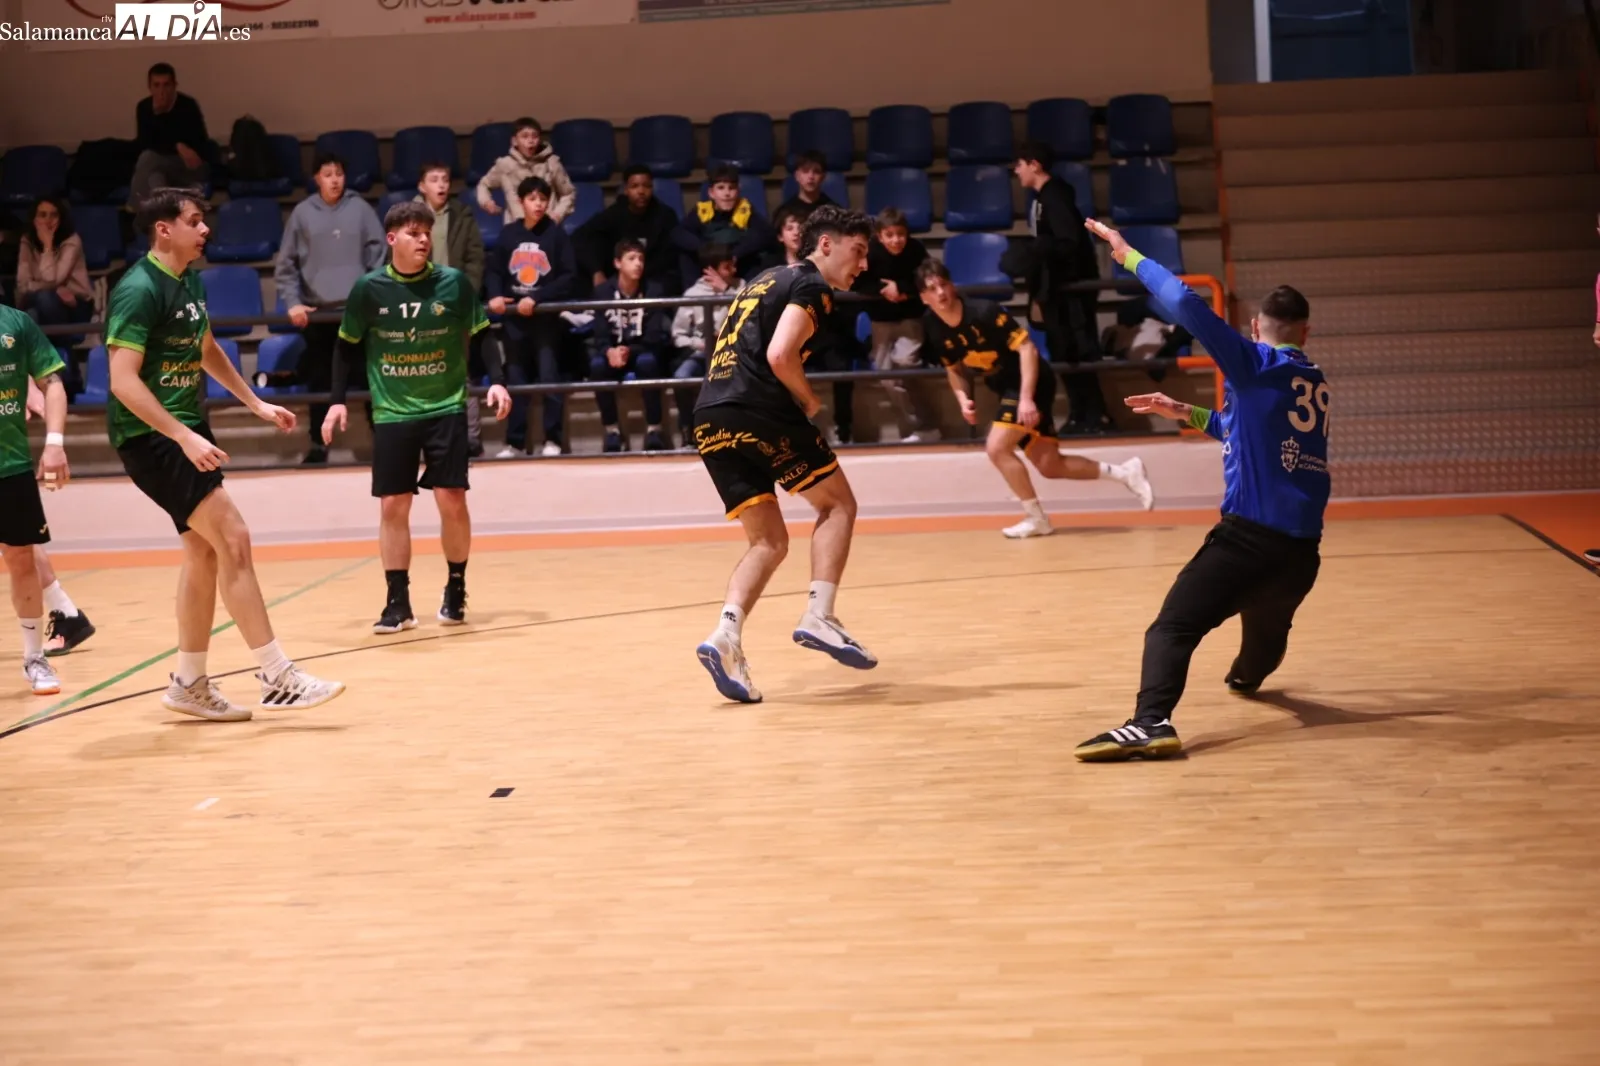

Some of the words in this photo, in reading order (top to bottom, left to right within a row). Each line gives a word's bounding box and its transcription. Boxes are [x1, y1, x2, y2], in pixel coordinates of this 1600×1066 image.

[399, 302, 421, 318] 17
[382, 361, 446, 376] CAMARGO
[1288, 376, 1329, 438] 39
